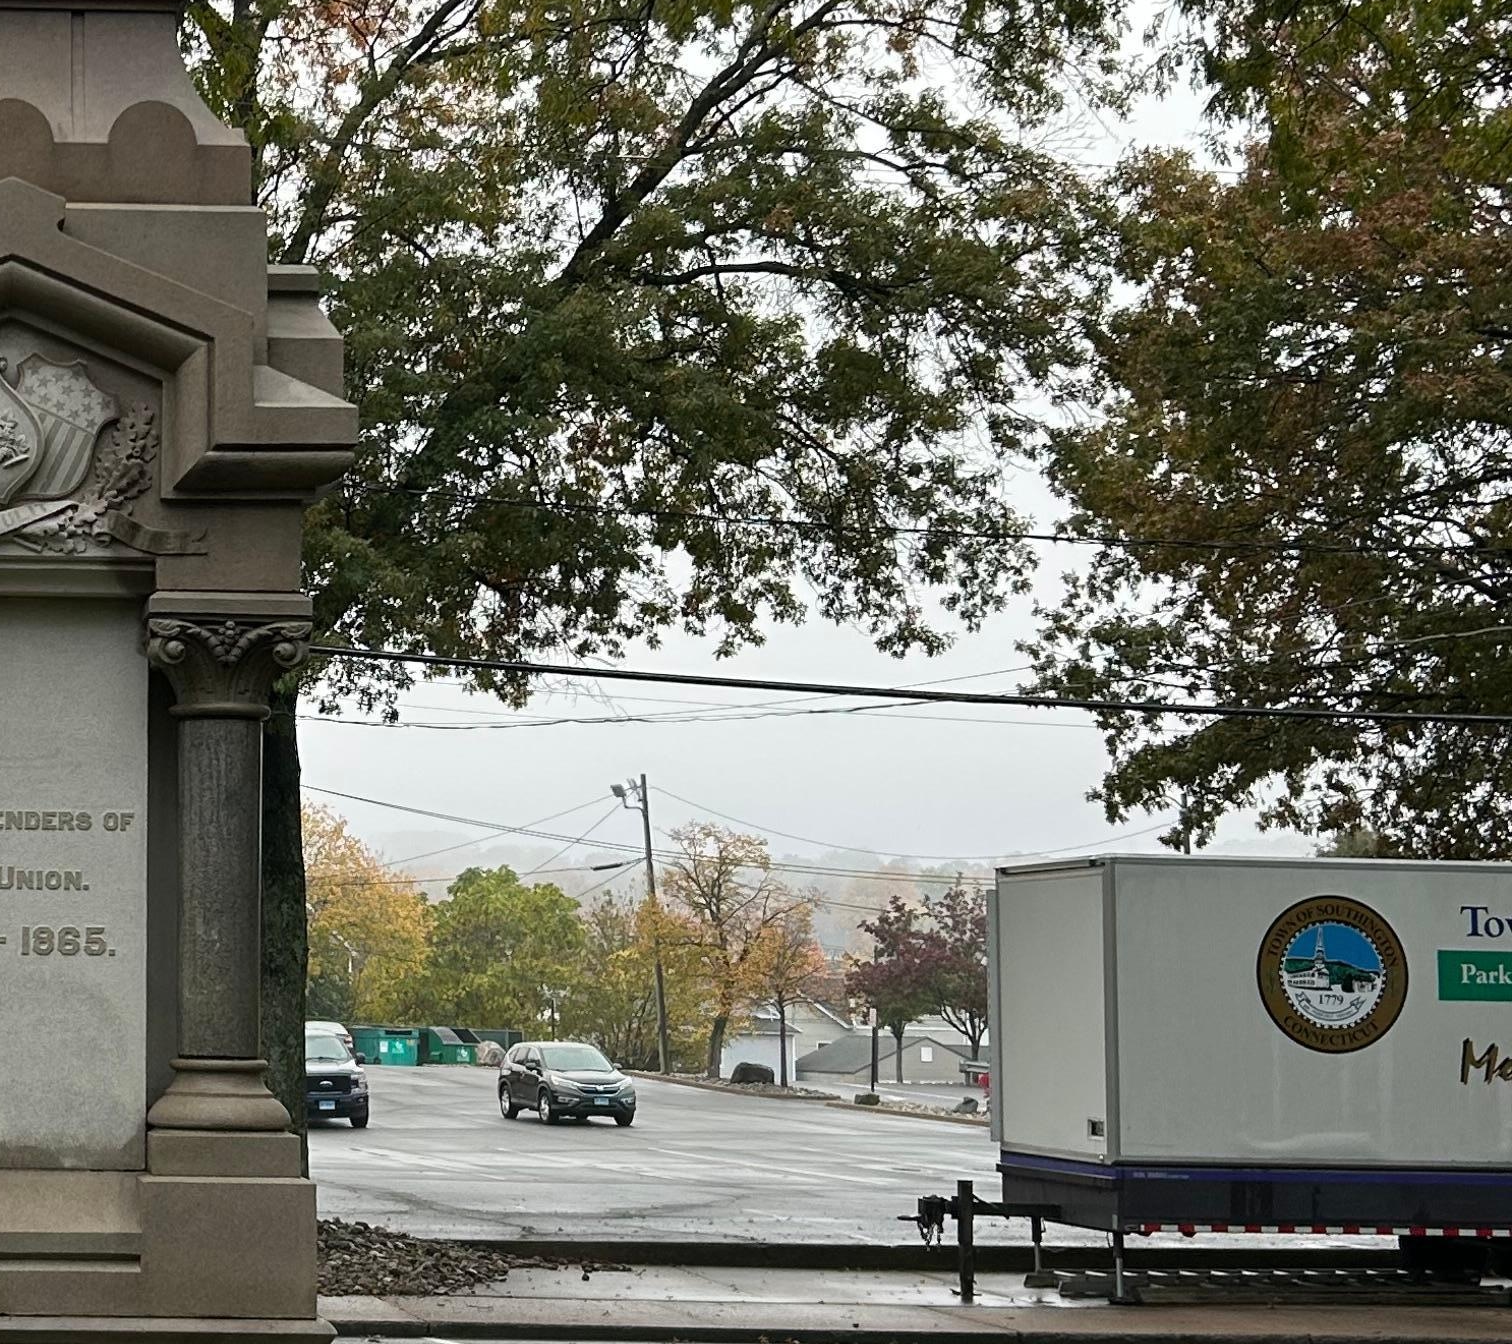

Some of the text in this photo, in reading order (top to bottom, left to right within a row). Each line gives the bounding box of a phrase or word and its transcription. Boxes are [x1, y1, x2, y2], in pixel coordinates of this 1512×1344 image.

[103, 812, 134, 832] OF
[1296, 908, 1314, 923] OF
[1316, 904, 1397, 968] SOUTHINGTON
[1460, 905, 1512, 938] To
[1319, 994, 1344, 1005] 1779
[1284, 1015, 1379, 1046] CONNECTICUT
